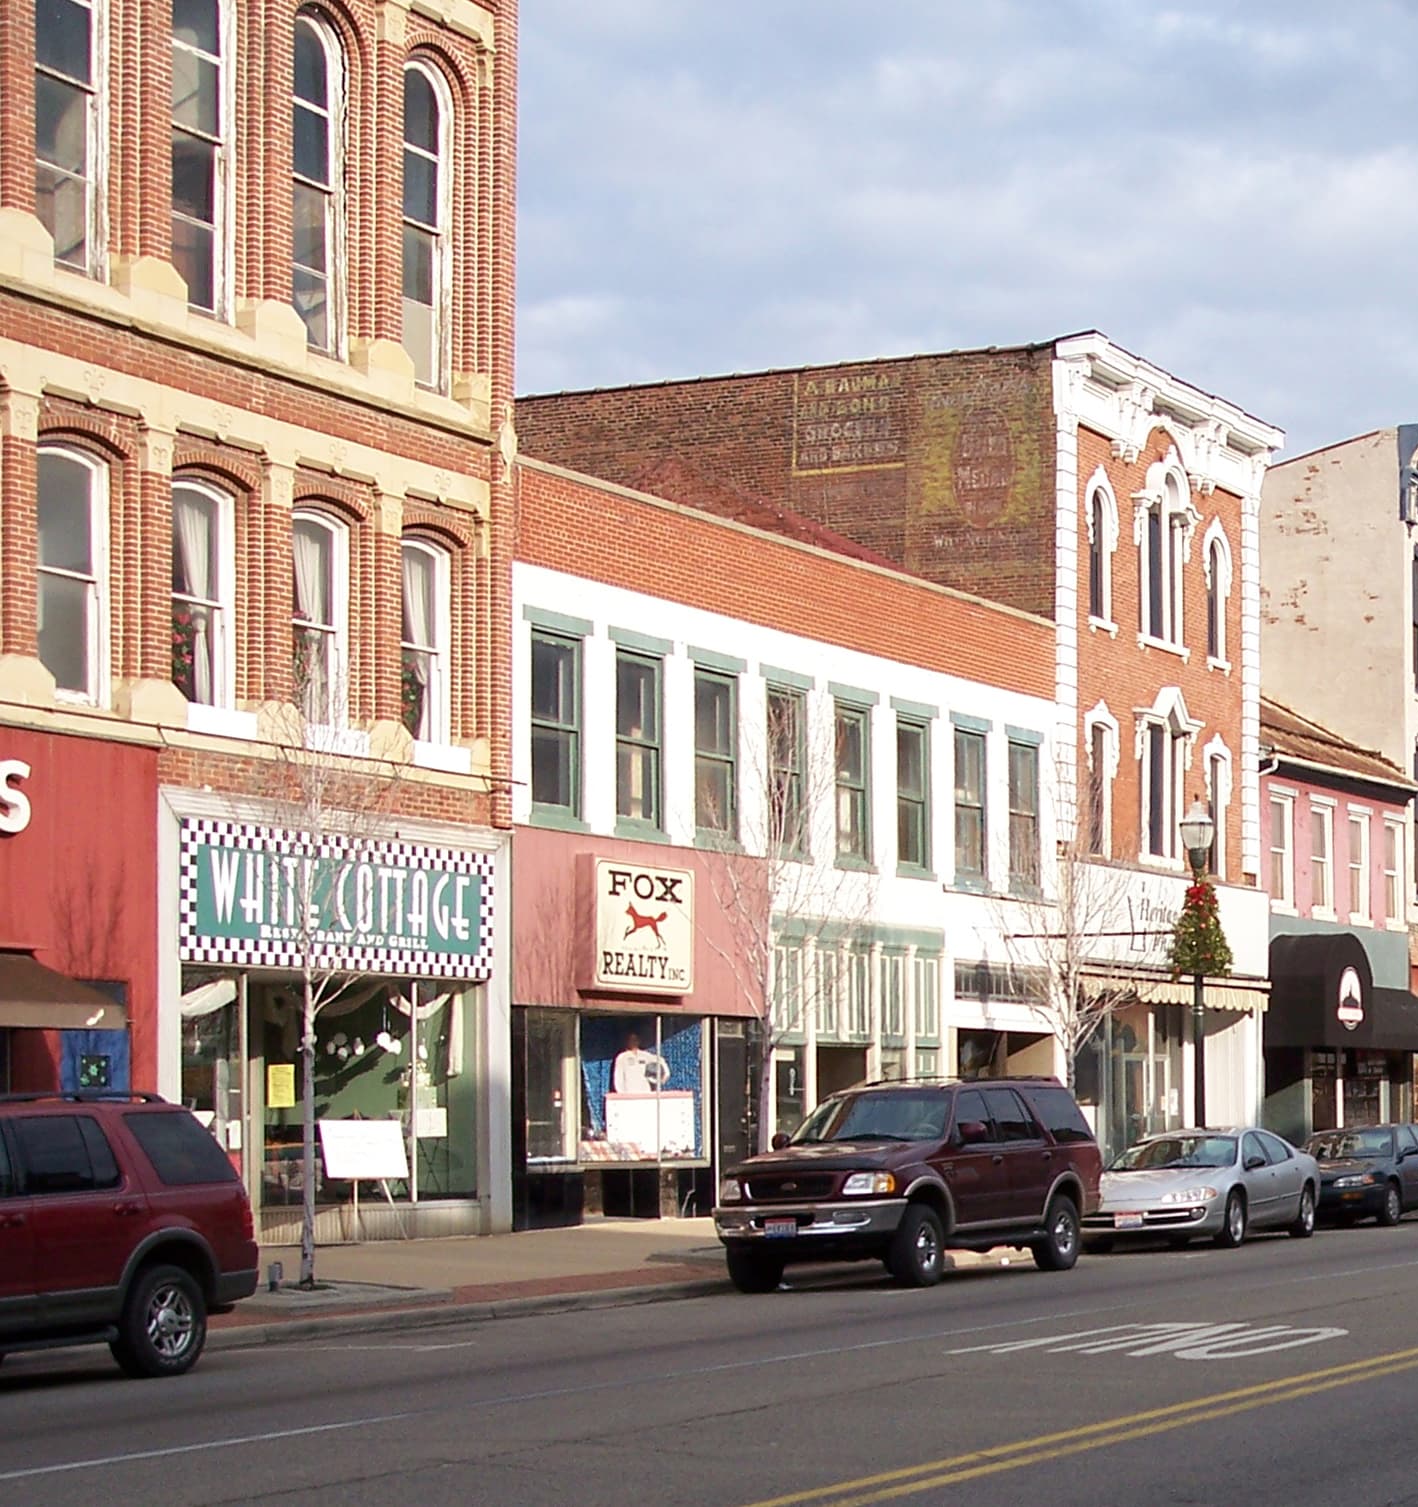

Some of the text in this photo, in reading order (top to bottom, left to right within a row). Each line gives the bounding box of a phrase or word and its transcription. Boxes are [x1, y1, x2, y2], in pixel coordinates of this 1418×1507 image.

[210, 848, 471, 941] WHITE COTTAGE
[608, 869, 683, 904] FOX
[387, 936, 428, 950] GRILL
[602, 950, 669, 980] REALTY
